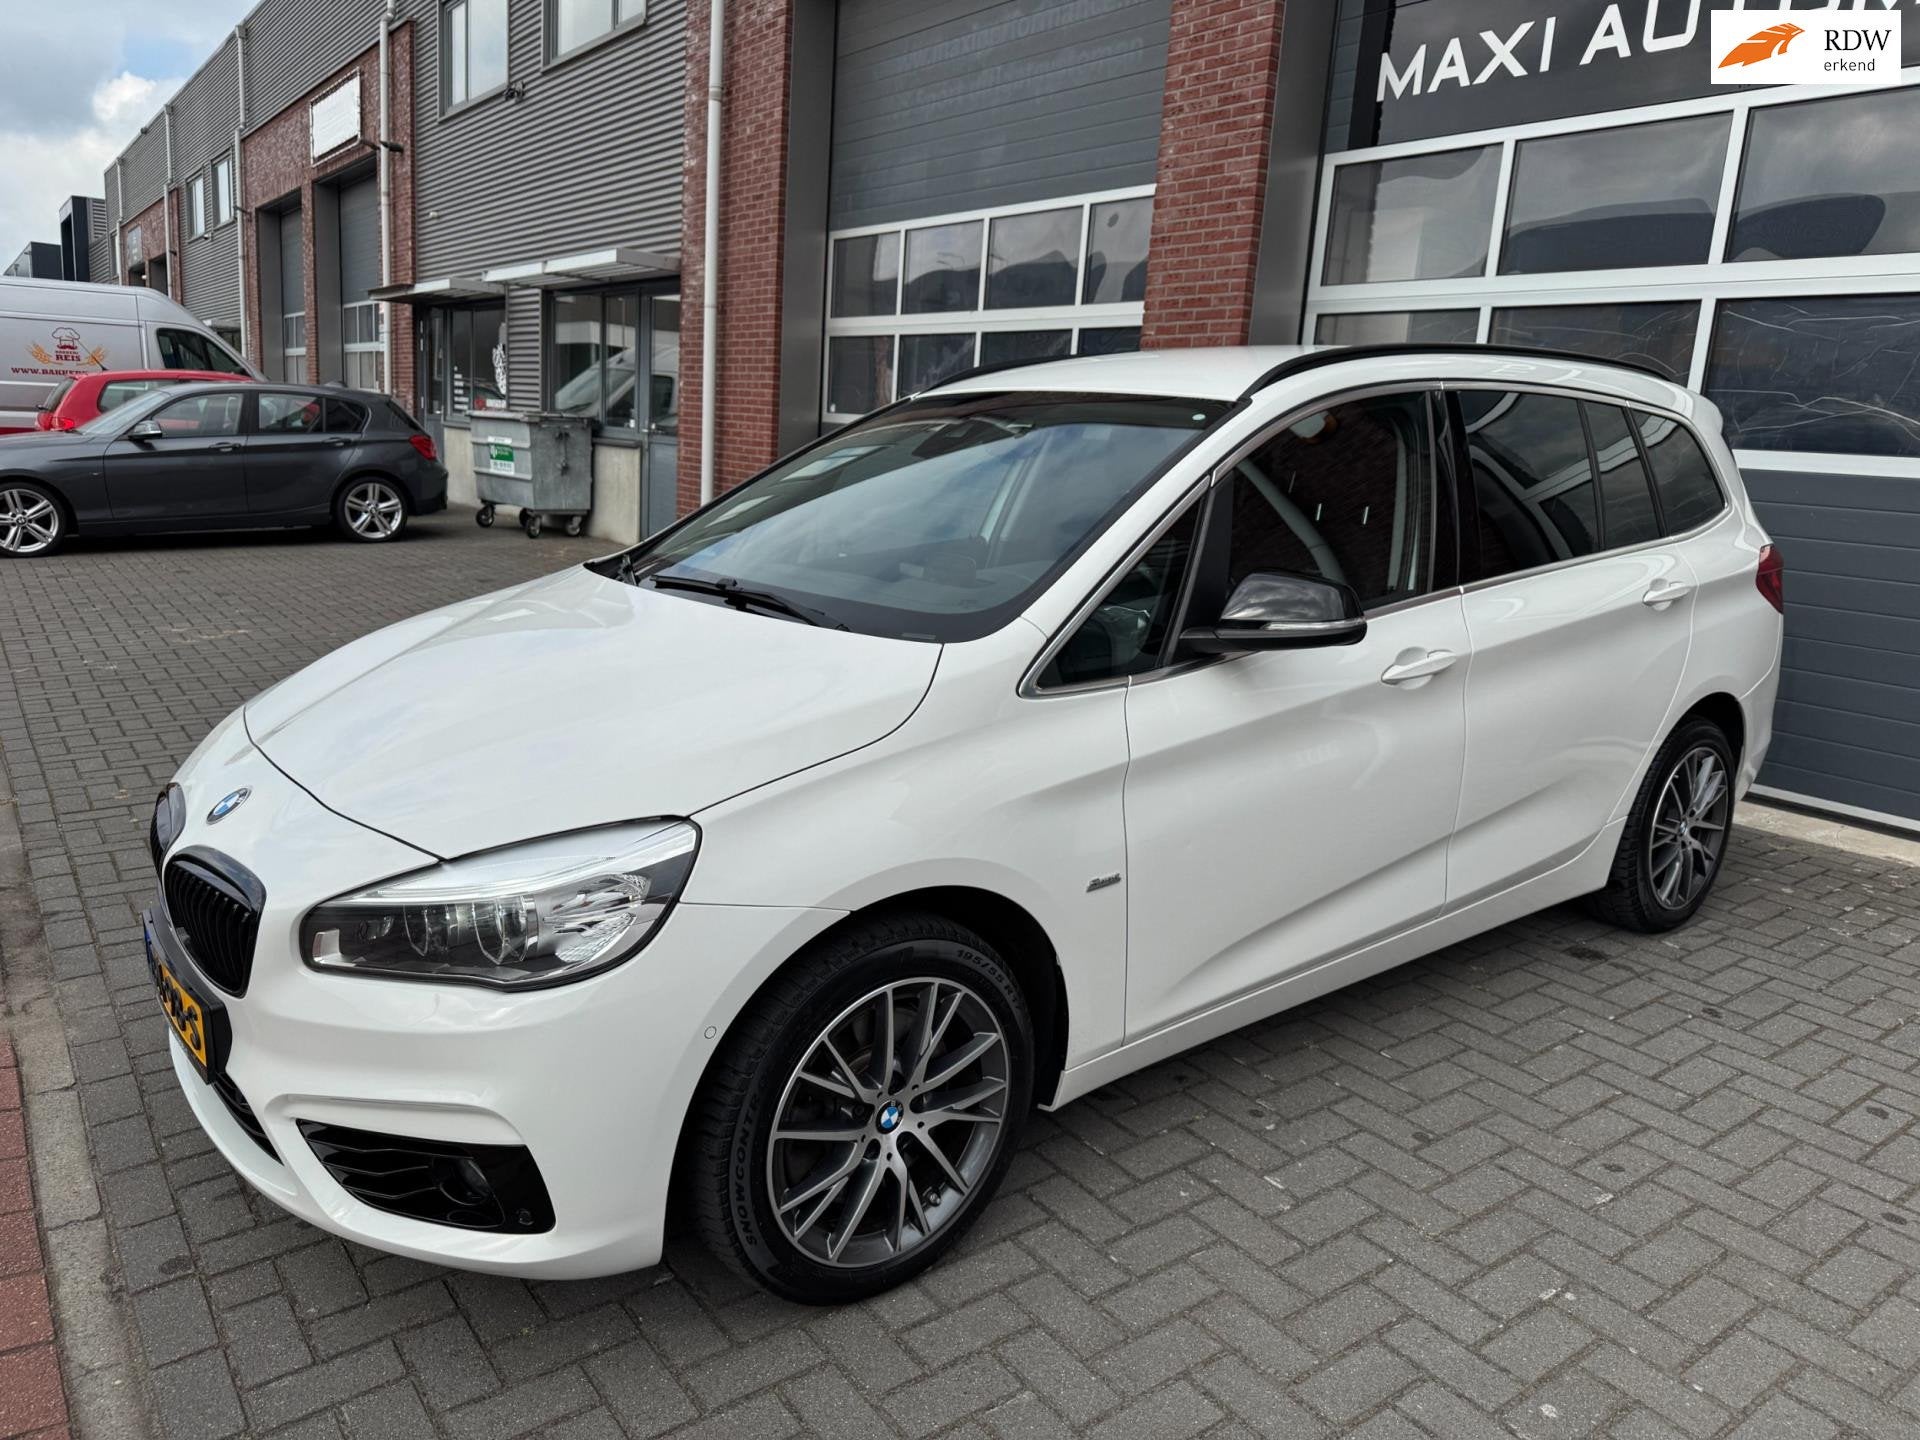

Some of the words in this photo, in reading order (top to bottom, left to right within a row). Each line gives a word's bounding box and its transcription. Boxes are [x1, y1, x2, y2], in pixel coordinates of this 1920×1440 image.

[1376, 16, 1557, 102] MAXI
[56, 354, 81, 362] REIS
[734, 1092, 761, 1246] SNOWCONTR
